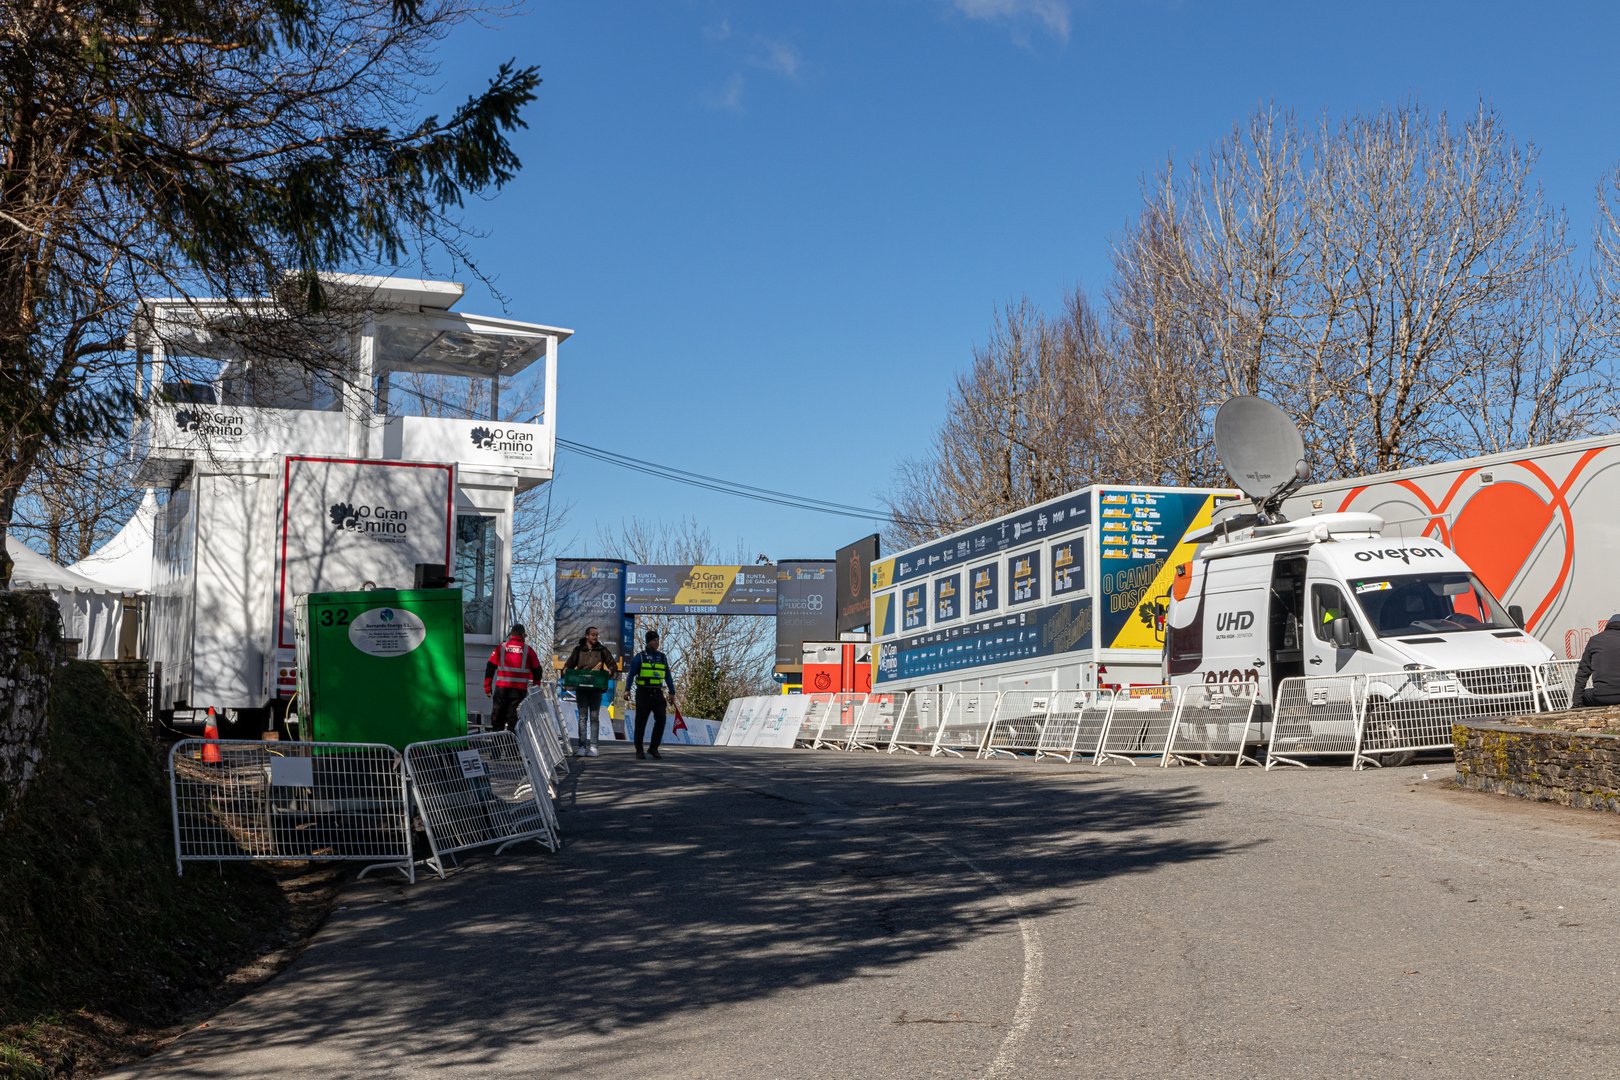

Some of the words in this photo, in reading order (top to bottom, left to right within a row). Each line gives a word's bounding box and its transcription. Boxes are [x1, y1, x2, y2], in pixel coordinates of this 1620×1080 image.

[214, 412, 243, 425] Gran
[493, 428, 504, 440] O
[506, 429, 534, 442] Gran
[358, 505, 371, 518] O
[374, 506, 408, 520] Gran
[1354, 547, 1443, 565] overon
[692, 572, 701, 580] O
[703, 572, 725, 581] Gran
[1102, 573, 1114, 595] O
[583, 600, 602, 608] LUGO
[640, 605, 668, 613] 01:37:31
[1110, 589, 1138, 614] DOS
[320, 608, 350, 627] 32
[1216, 610, 1255, 632] UHD
[1202, 668, 1260, 699] eron
